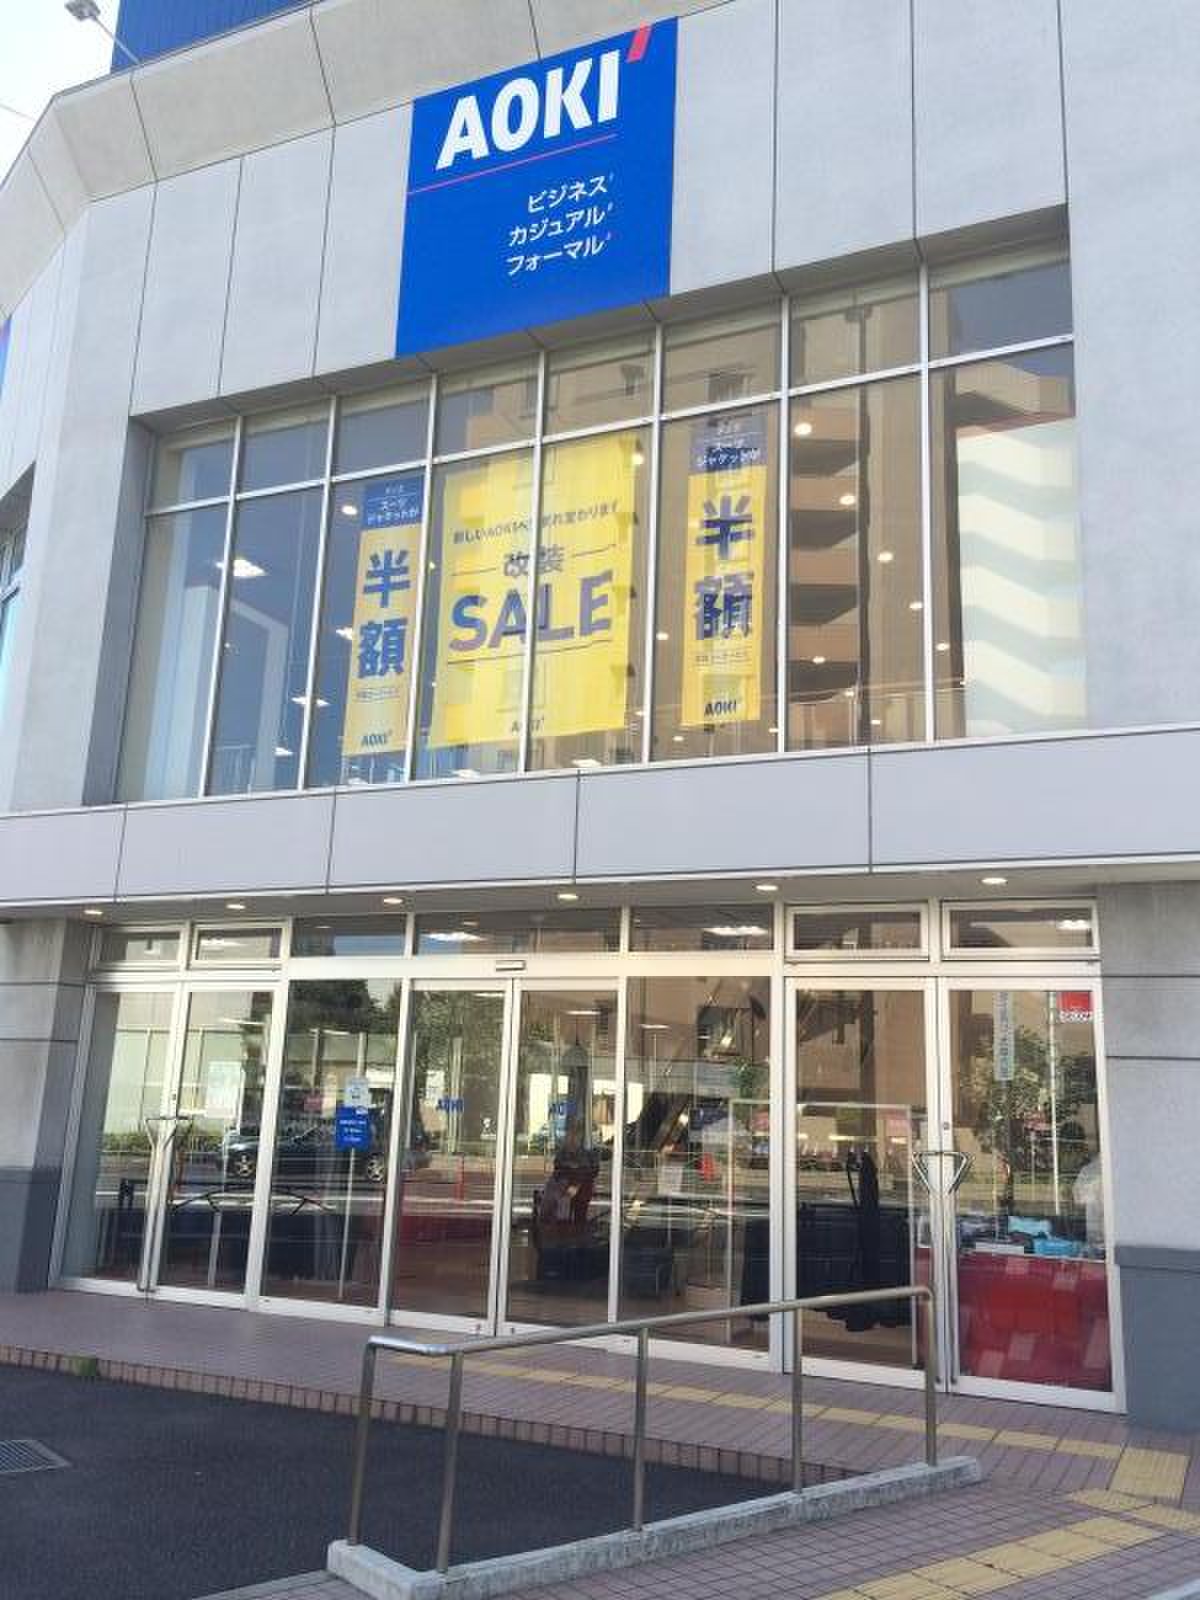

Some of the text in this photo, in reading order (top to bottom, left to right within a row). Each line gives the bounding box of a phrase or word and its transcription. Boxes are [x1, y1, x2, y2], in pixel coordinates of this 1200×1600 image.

[436, 50, 620, 171] AOKI
[528, 175, 608, 213] ビジネス
[506, 236, 605, 276] フォーマル
[508, 207, 606, 247] カジュアル
[357, 548, 411, 679] 半額
[450, 570, 613, 652] SALE
